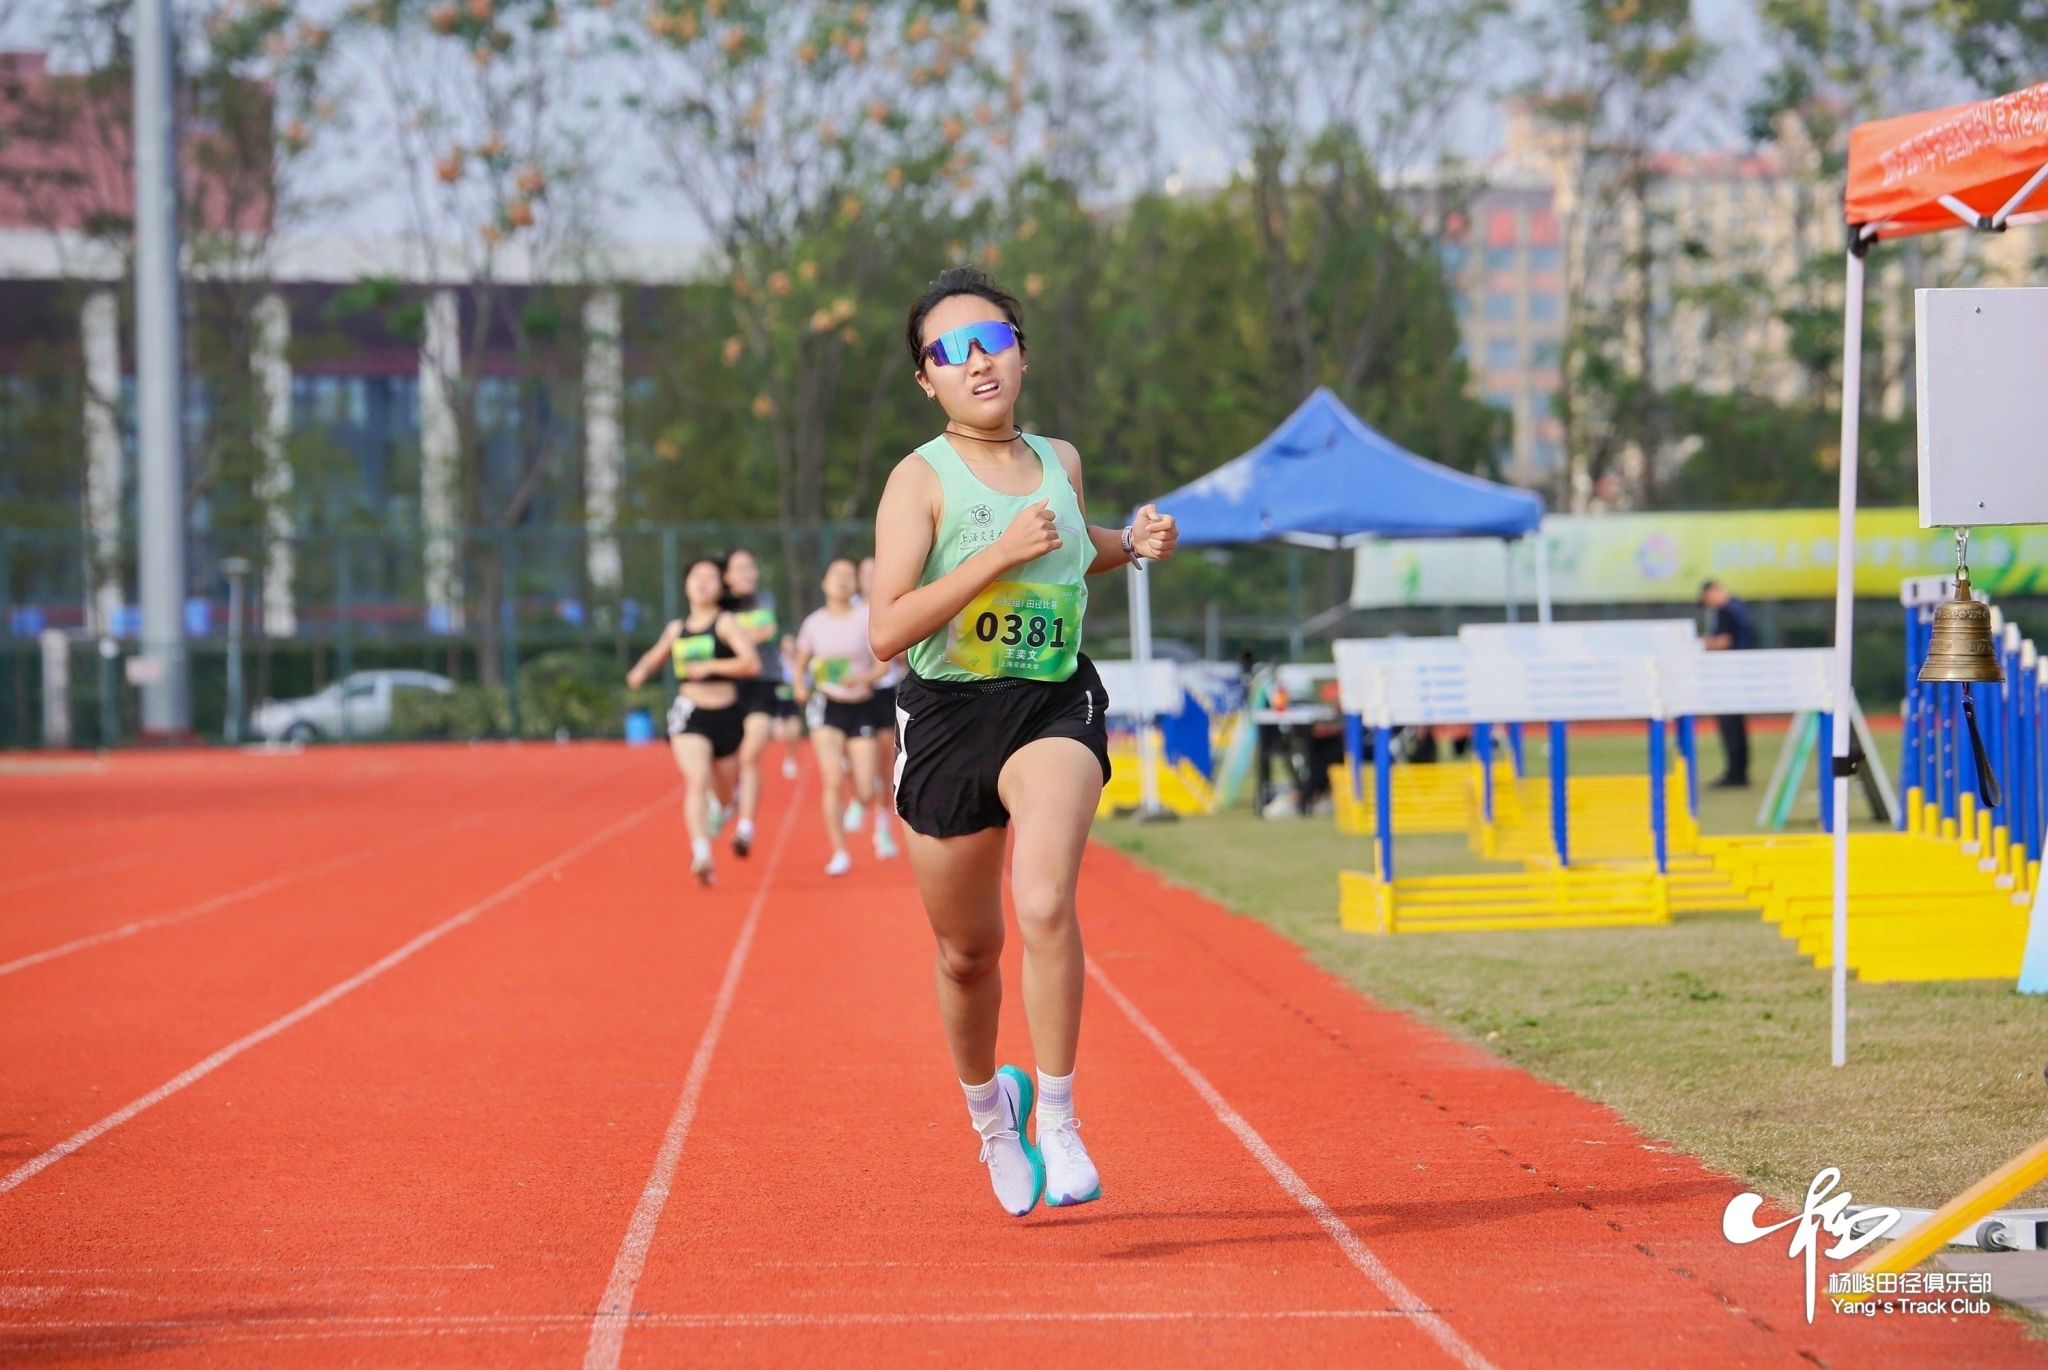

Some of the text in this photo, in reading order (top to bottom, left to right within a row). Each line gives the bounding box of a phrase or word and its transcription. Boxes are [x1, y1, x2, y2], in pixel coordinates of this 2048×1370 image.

[975, 611, 1065, 648] 0381
[1004, 648, 1037, 661] 王奕文
